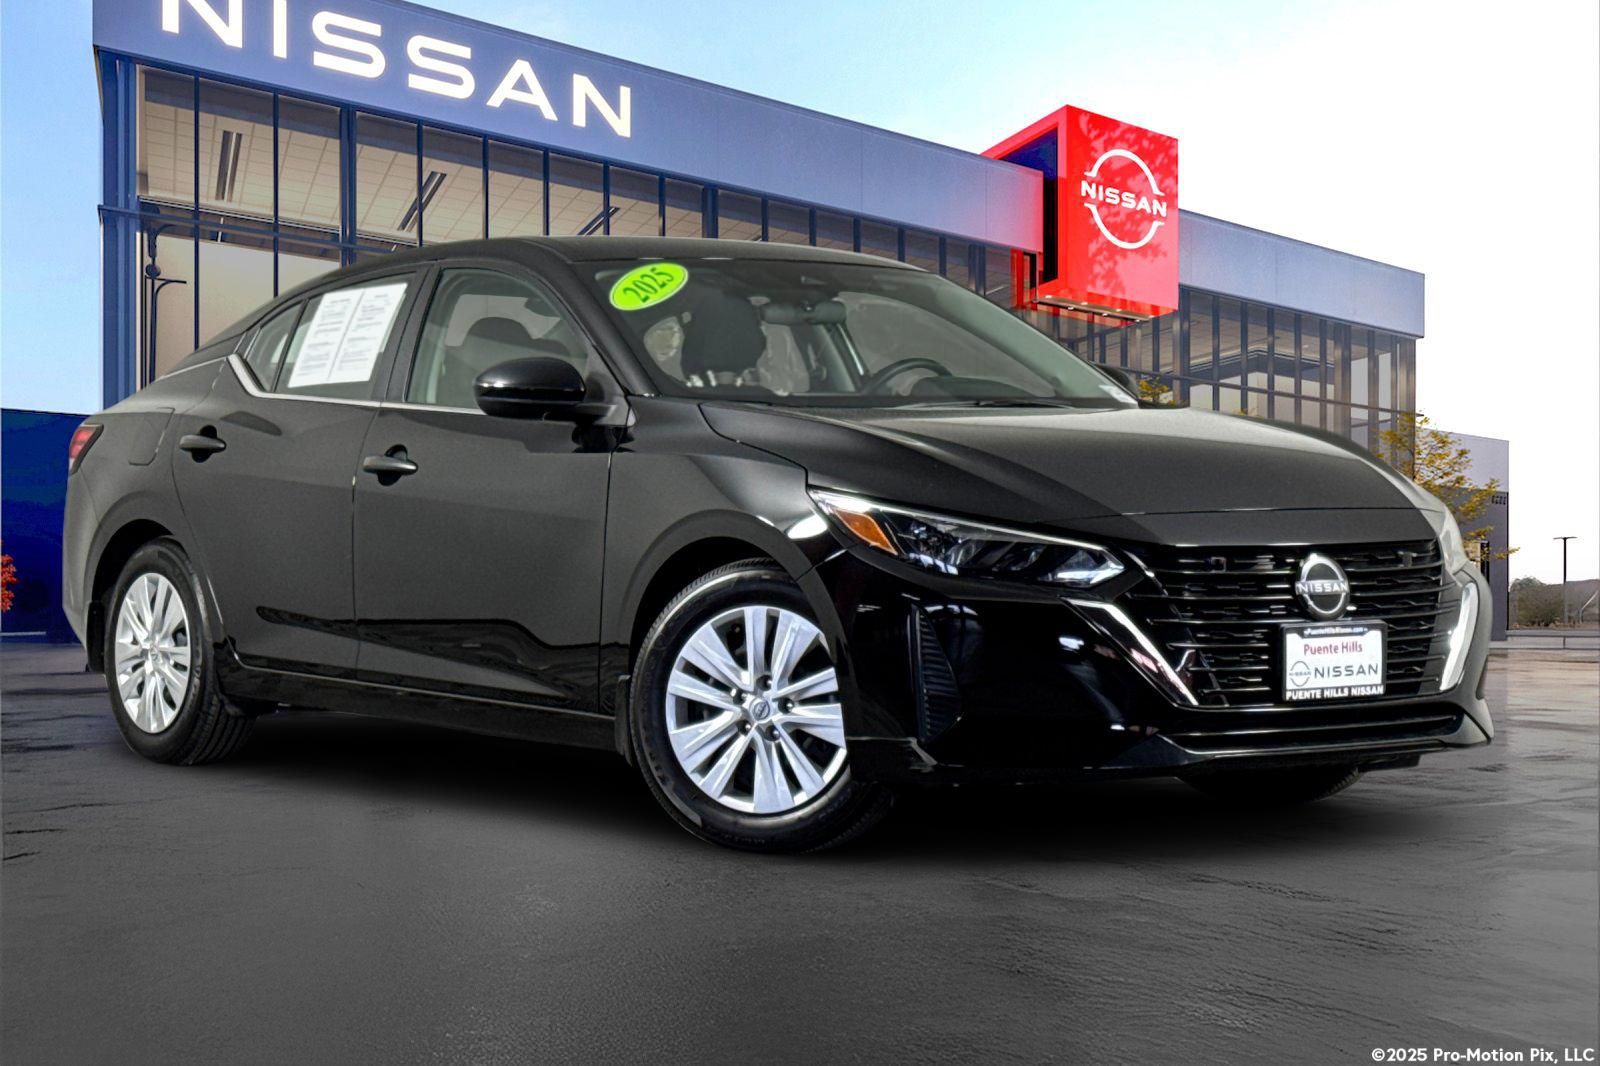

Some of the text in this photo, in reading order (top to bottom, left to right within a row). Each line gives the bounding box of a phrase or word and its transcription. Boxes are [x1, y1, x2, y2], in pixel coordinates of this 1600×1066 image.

[161, 0, 632, 138] NISSAN
[1080, 179, 1167, 217] NISSAN
[623, 267, 674, 303] 2025
[1295, 581, 1349, 594] NISSAN
[1303, 640, 1363, 656] Puente Hills
[1314, 663, 1378, 679] NISSAN
[1286, 684, 1384, 700] PUENTE HILLS NISSAN
